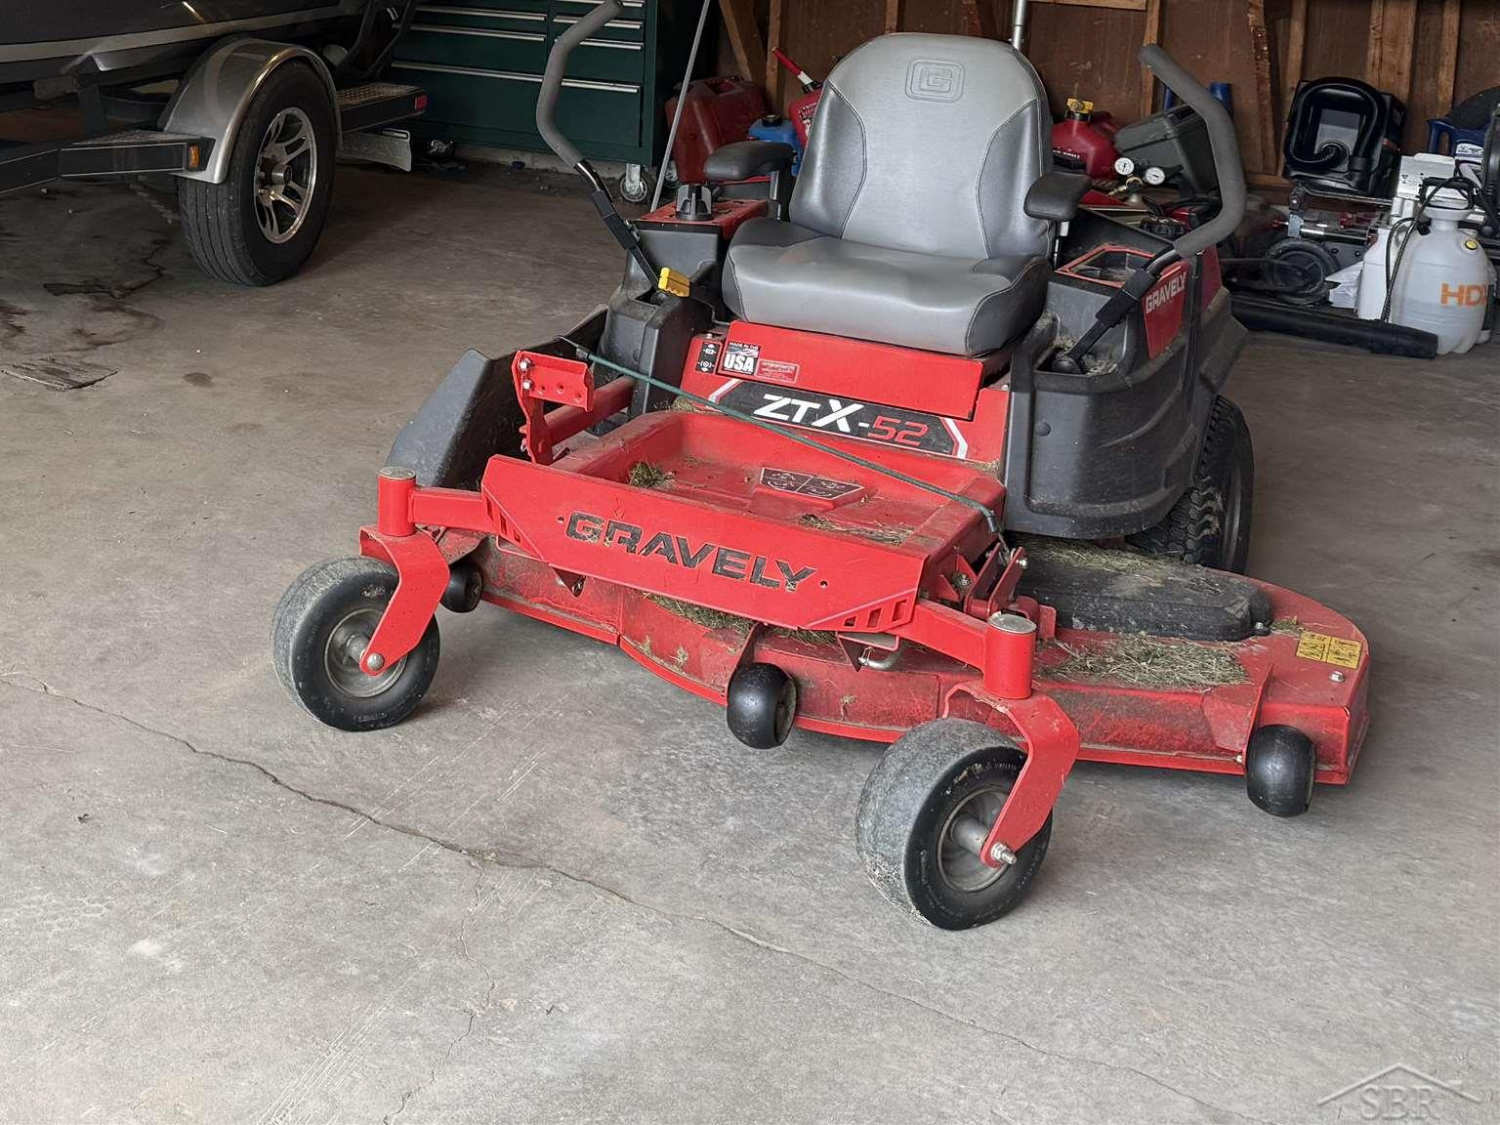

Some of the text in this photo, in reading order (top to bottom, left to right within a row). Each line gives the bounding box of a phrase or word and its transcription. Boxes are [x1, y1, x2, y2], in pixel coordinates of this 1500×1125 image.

[1145, 271, 1187, 314] GRAVELY
[1439, 283, 1488, 307] HD
[724, 353, 755, 373] USA
[753, 393, 929, 446] ZTX-52
[565, 511, 817, 591] GRAVELY
